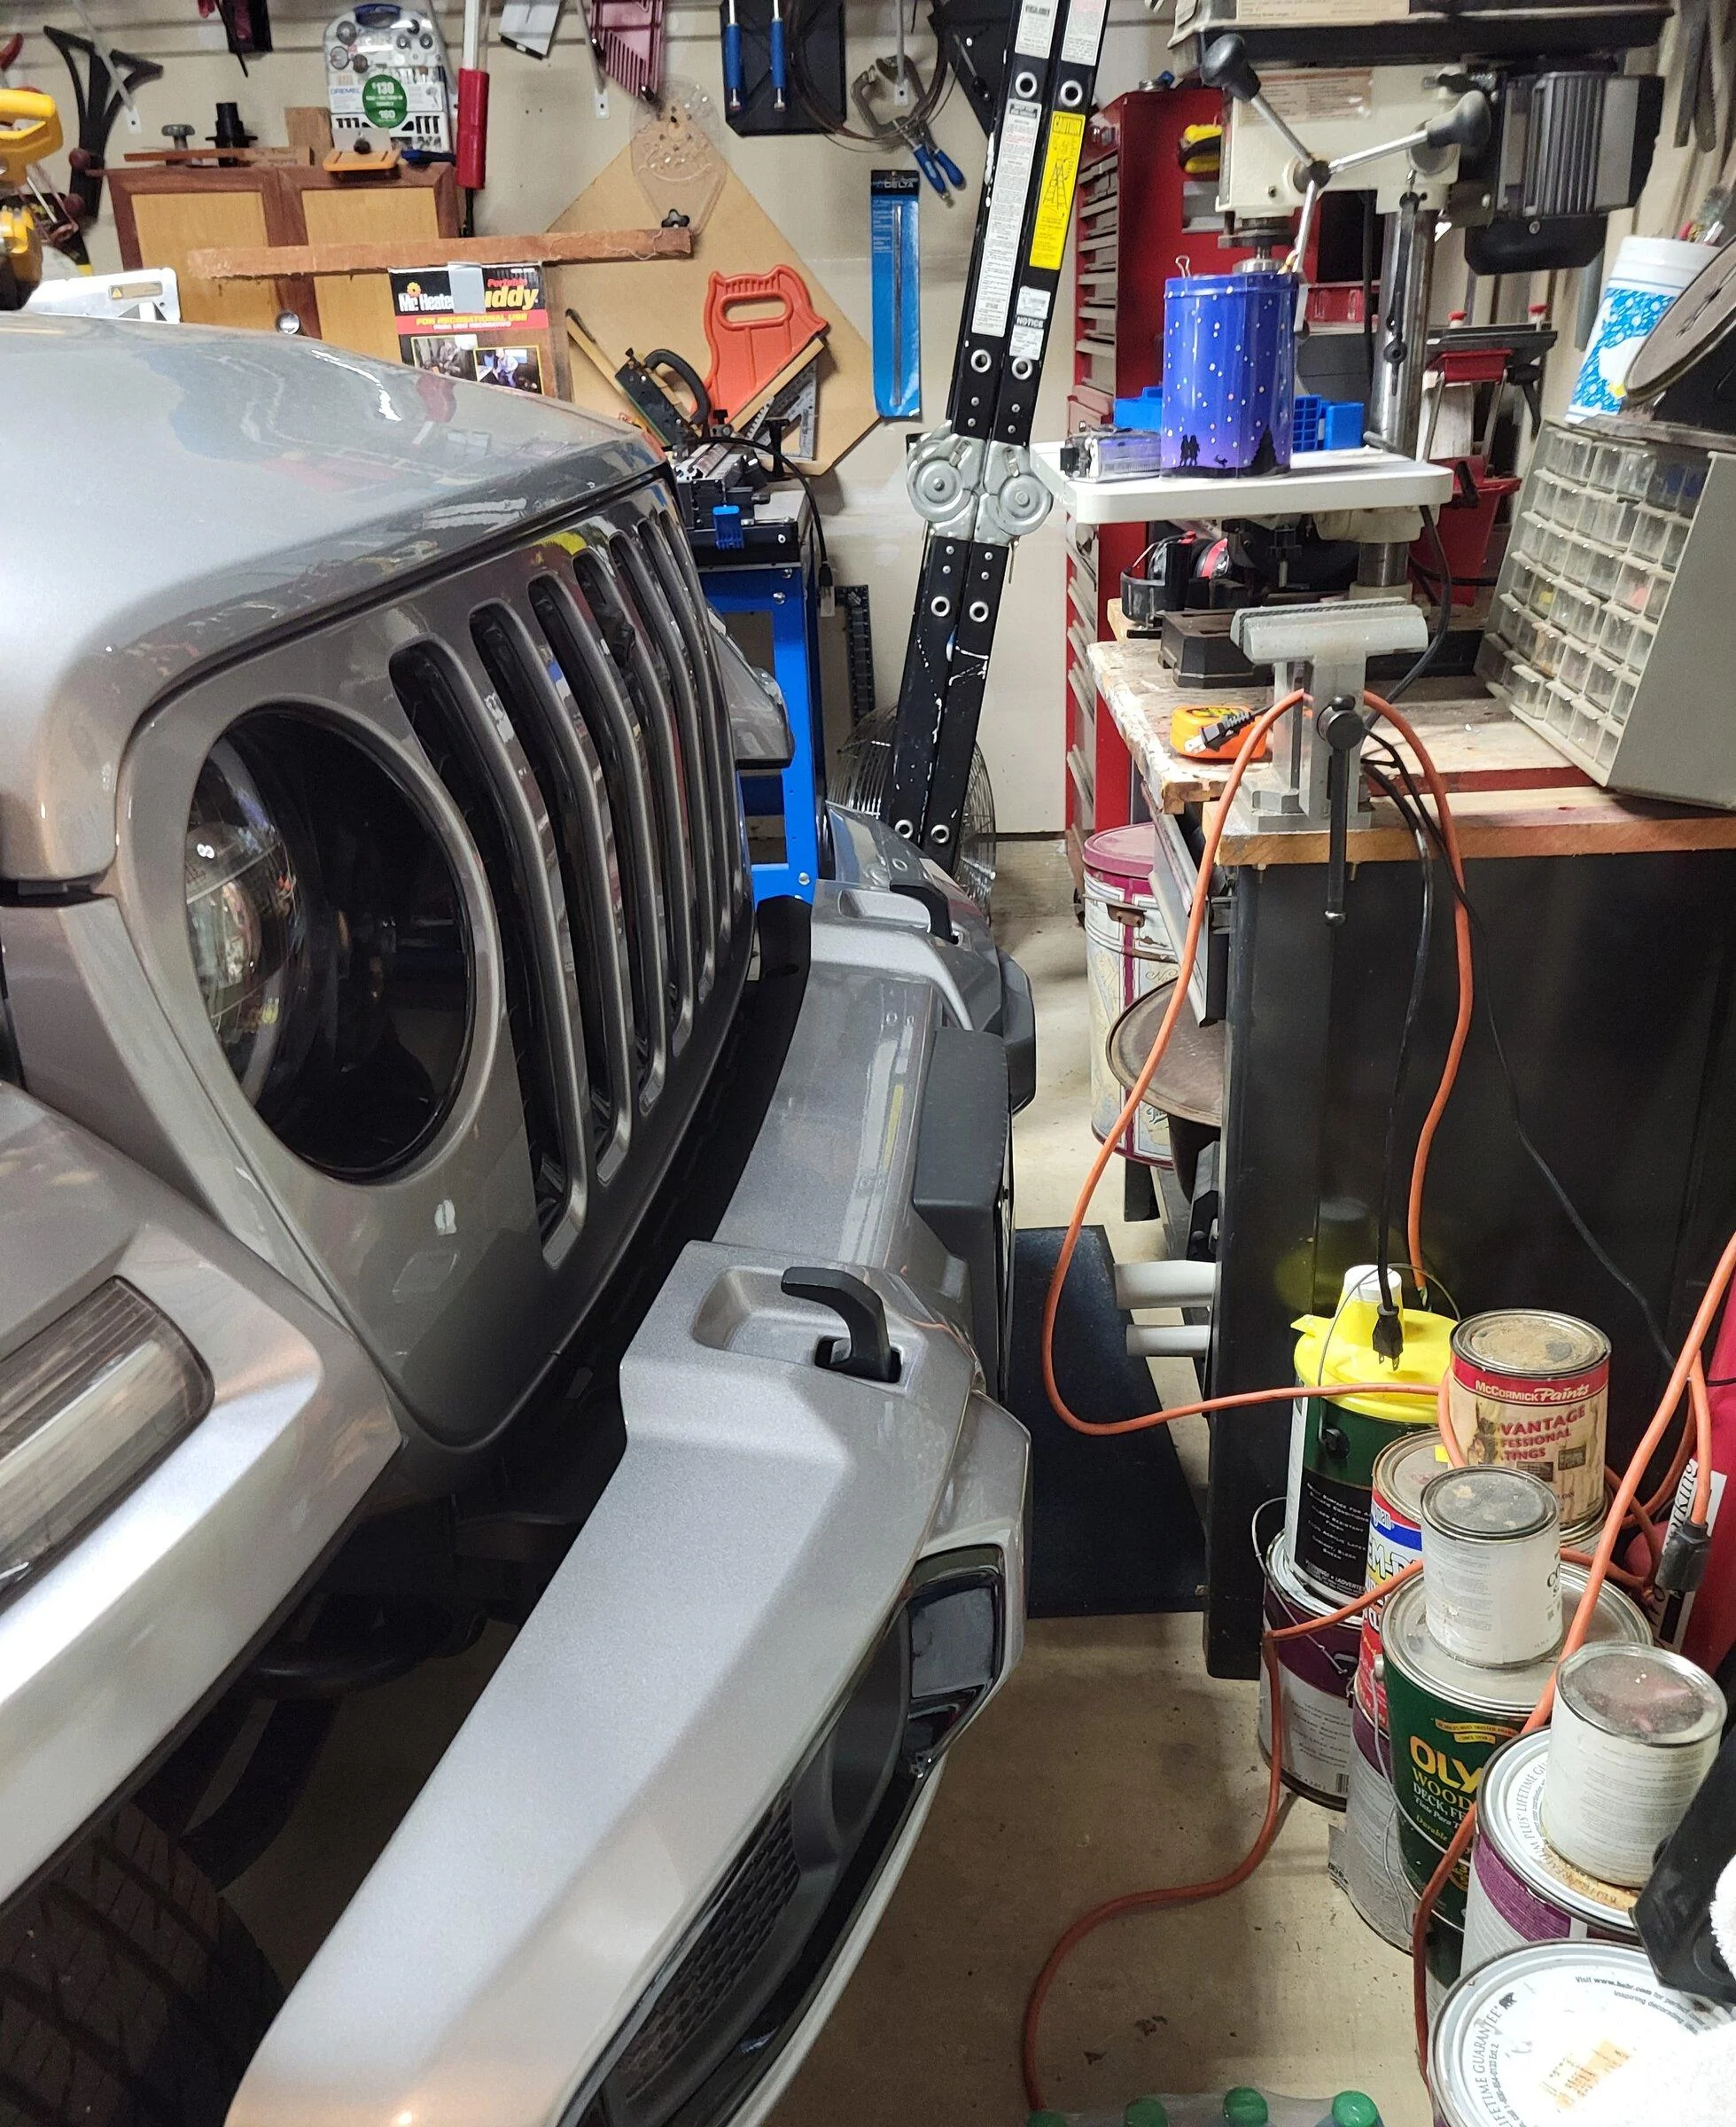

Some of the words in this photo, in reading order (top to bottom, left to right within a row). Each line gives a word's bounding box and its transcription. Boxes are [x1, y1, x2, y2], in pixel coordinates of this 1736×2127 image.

[398, 292, 419, 312] Mr.
[485, 286, 539, 310] uddy
[1016, 316, 1044, 329] NOTICE
[1534, 1383, 1589, 1401] Paints
[1501, 1428, 1571, 1448] FESSIONAL
[1502, 1447, 1546, 1461] TINGS
[1411, 1765, 1473, 1812] WOOD
[1413, 1781, 1449, 1816] DECK,
[1515, 1773, 1537, 1814] LIFETIME
[1414, 1794, 1433, 1815] Tinte
[1433, 1810, 1452, 1827] Para
[1415, 1814, 1449, 1842] Durable
[1592, 1976, 1652, 1996] www.behr.com
[1653, 1991, 1665, 2000] for
[1647, 2000, 1685, 2024] decorating
